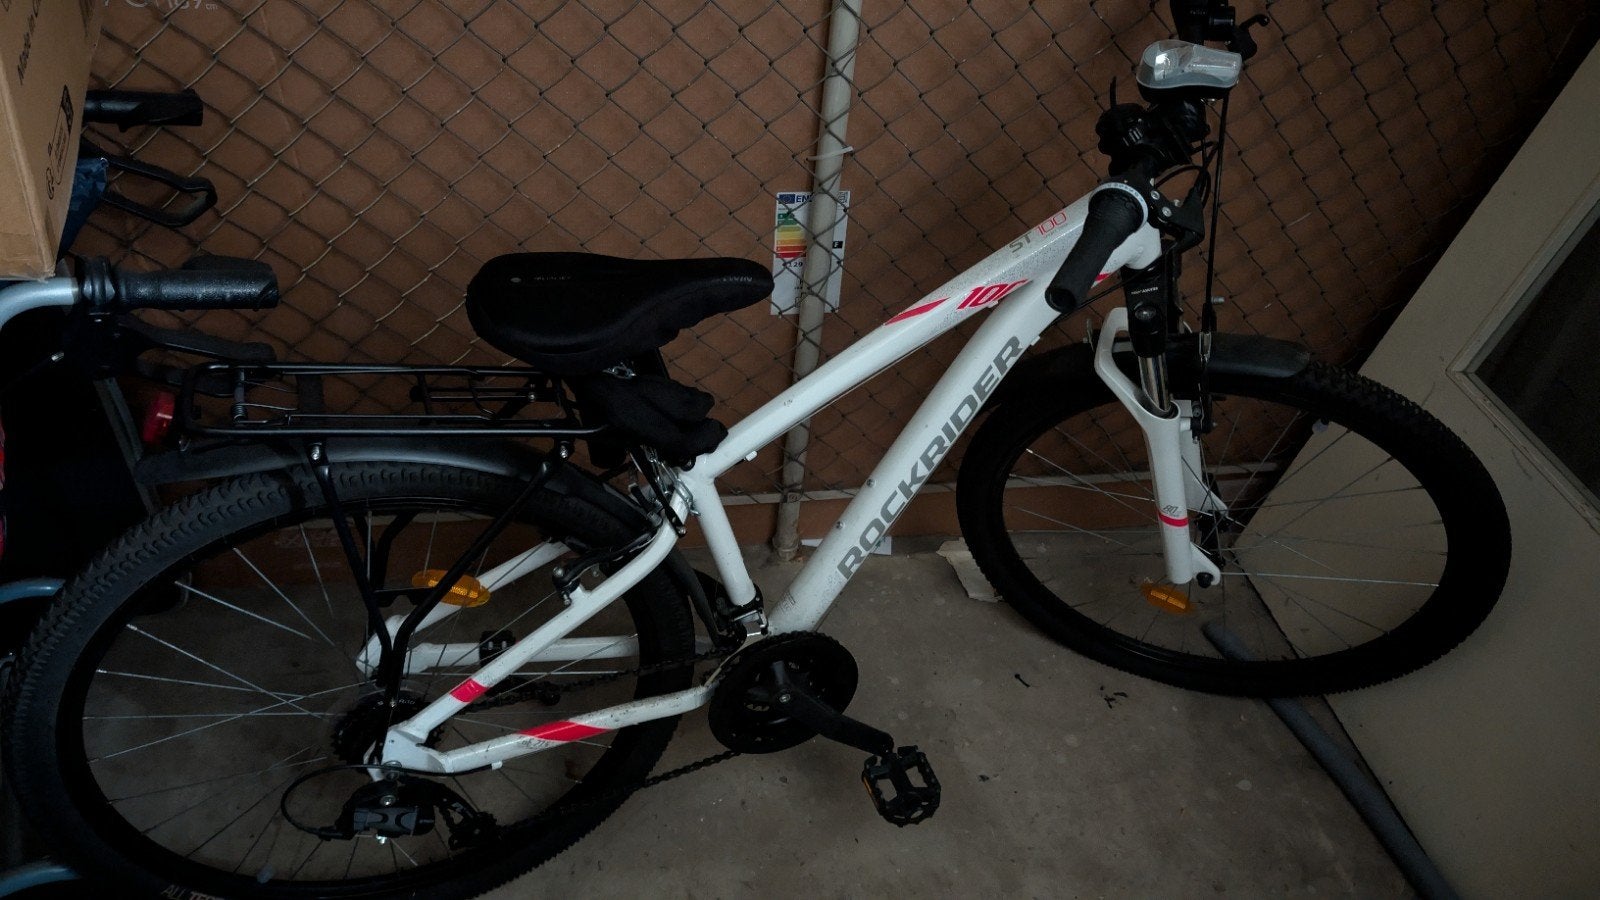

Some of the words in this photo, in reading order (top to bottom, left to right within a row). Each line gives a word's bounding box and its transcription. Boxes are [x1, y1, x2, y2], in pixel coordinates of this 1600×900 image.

[1009, 231, 1033, 253] ST
[1037, 211, 1067, 236] 100
[837, 336, 1024, 580] ROCKRIDER
